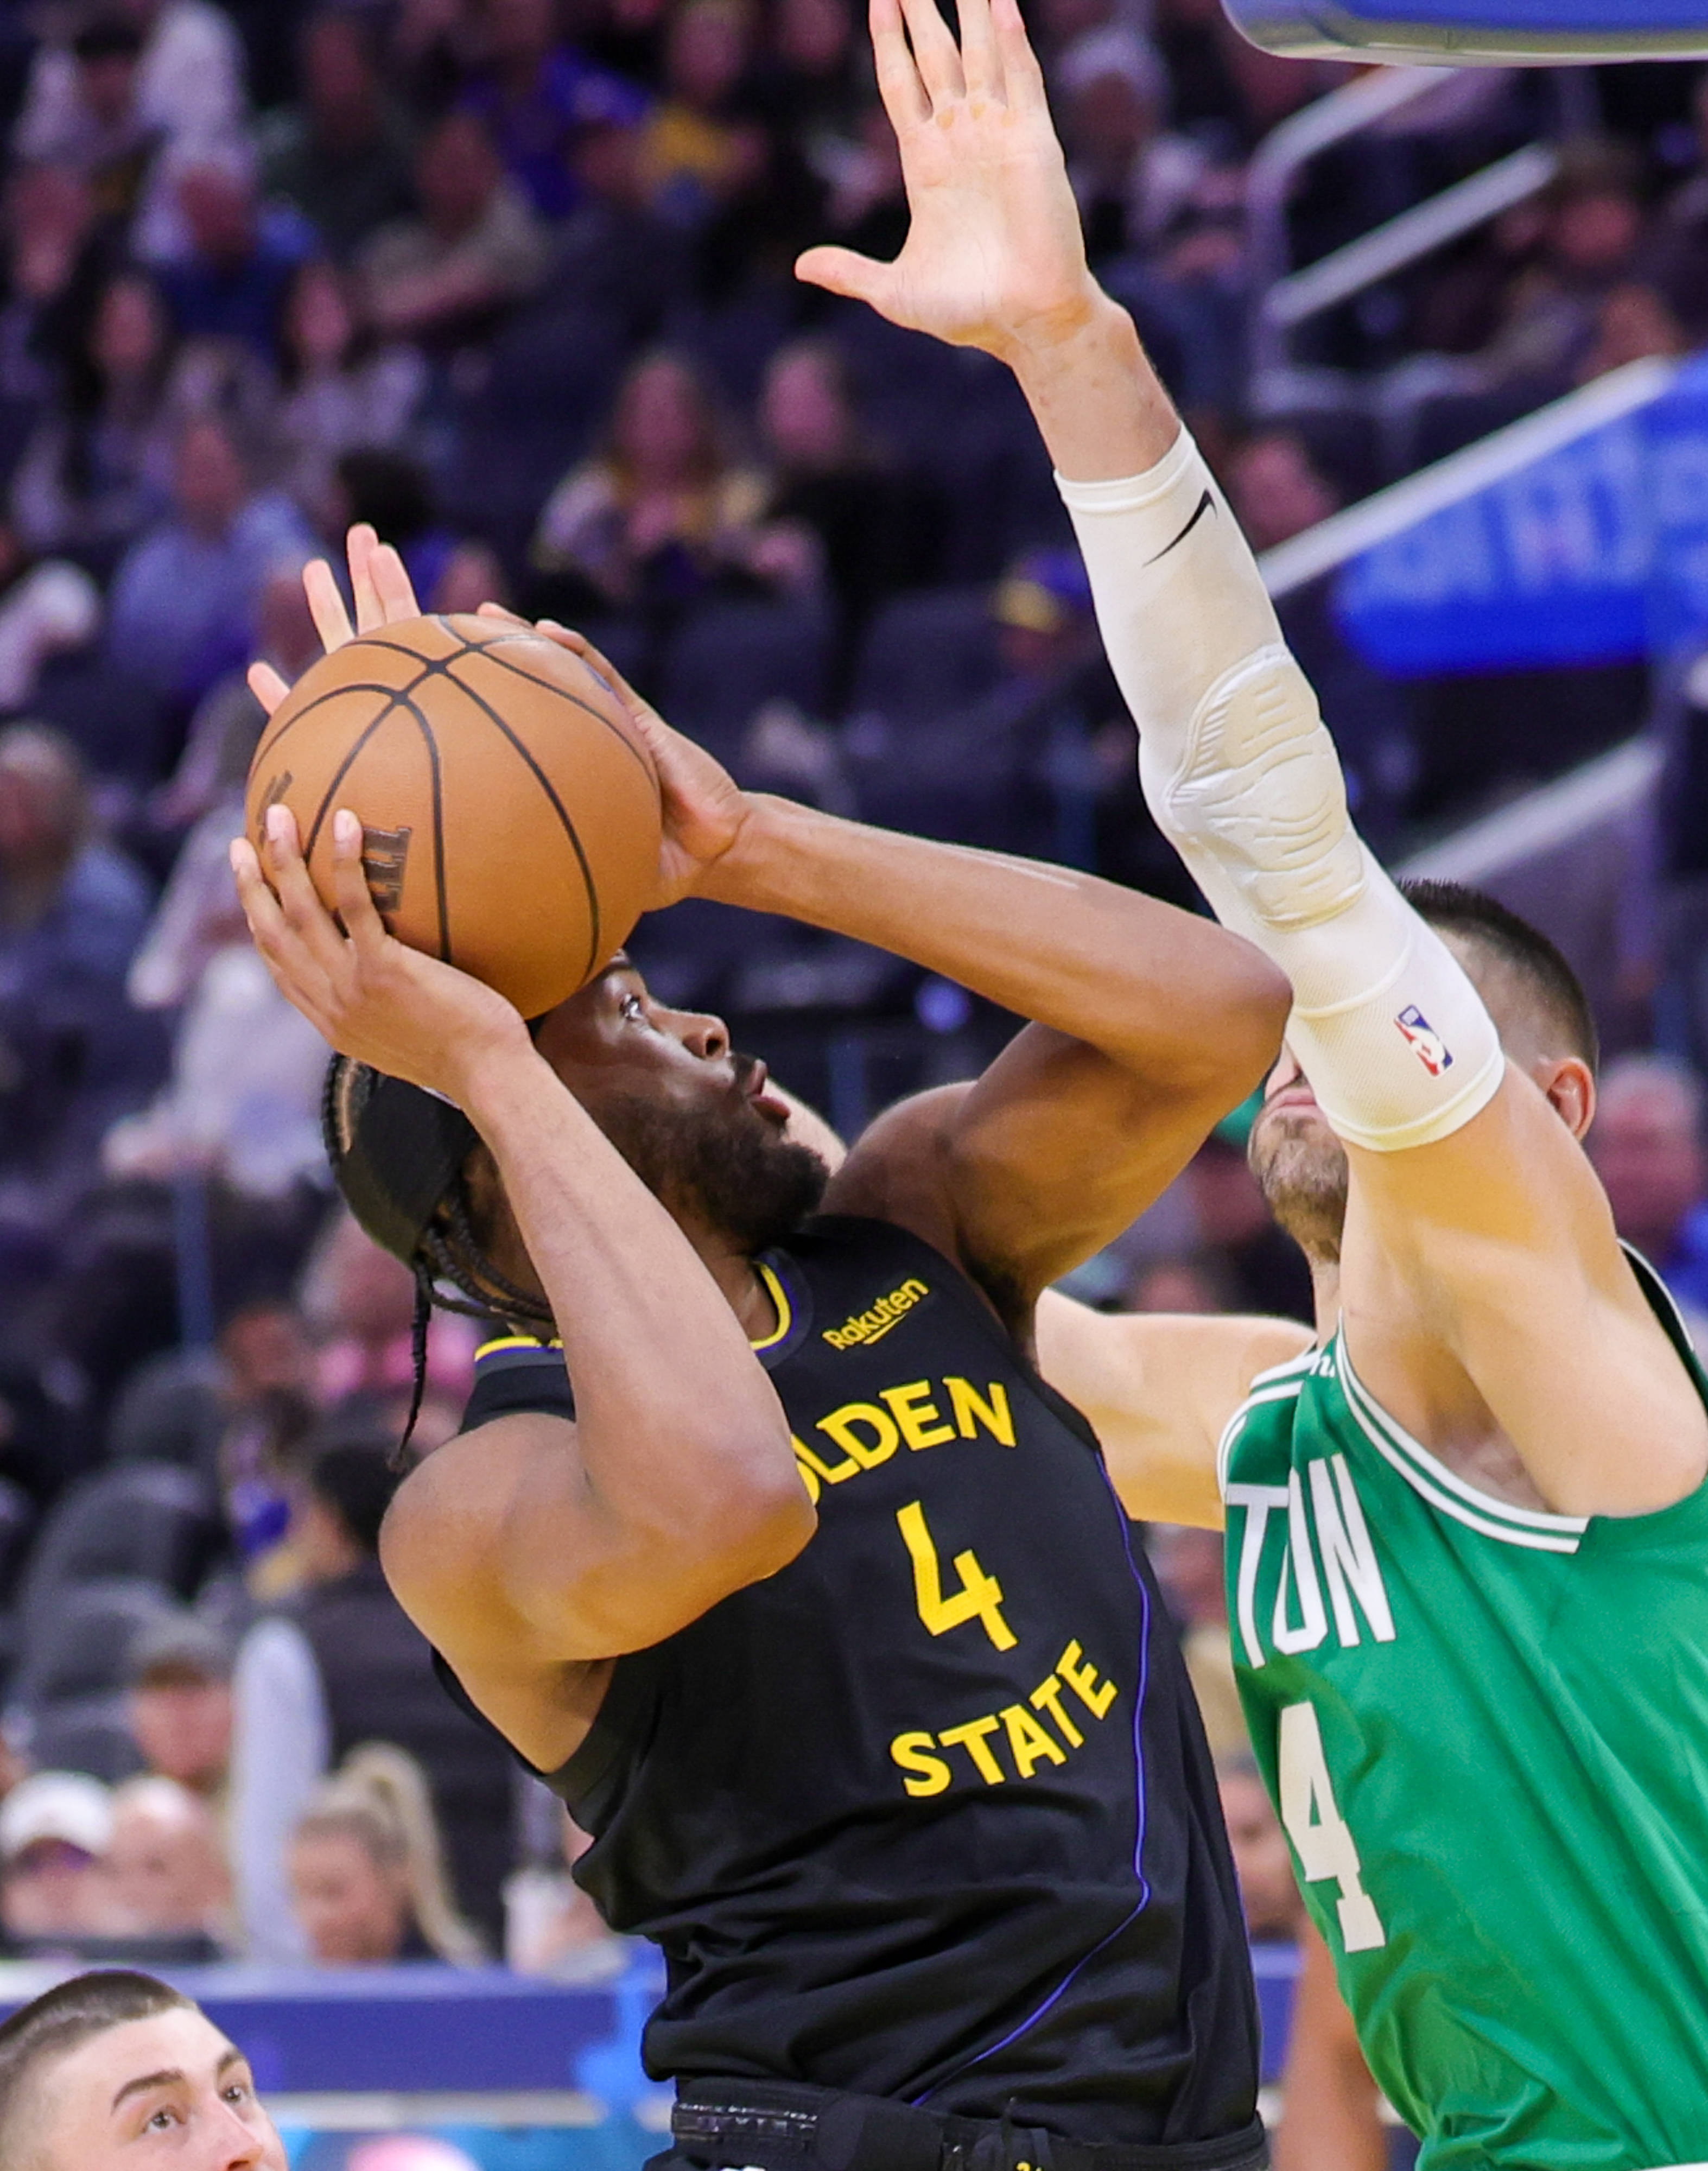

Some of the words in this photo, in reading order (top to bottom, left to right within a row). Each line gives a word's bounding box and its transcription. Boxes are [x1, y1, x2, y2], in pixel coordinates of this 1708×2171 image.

[822, 1279, 929, 1349] Rakuten
[791, 1377, 1016, 1506] LDEN
[896, 1501, 1017, 1651] 4
[890, 1639, 1117, 1796] STATE
[1279, 1701, 1386, 1952] 4
